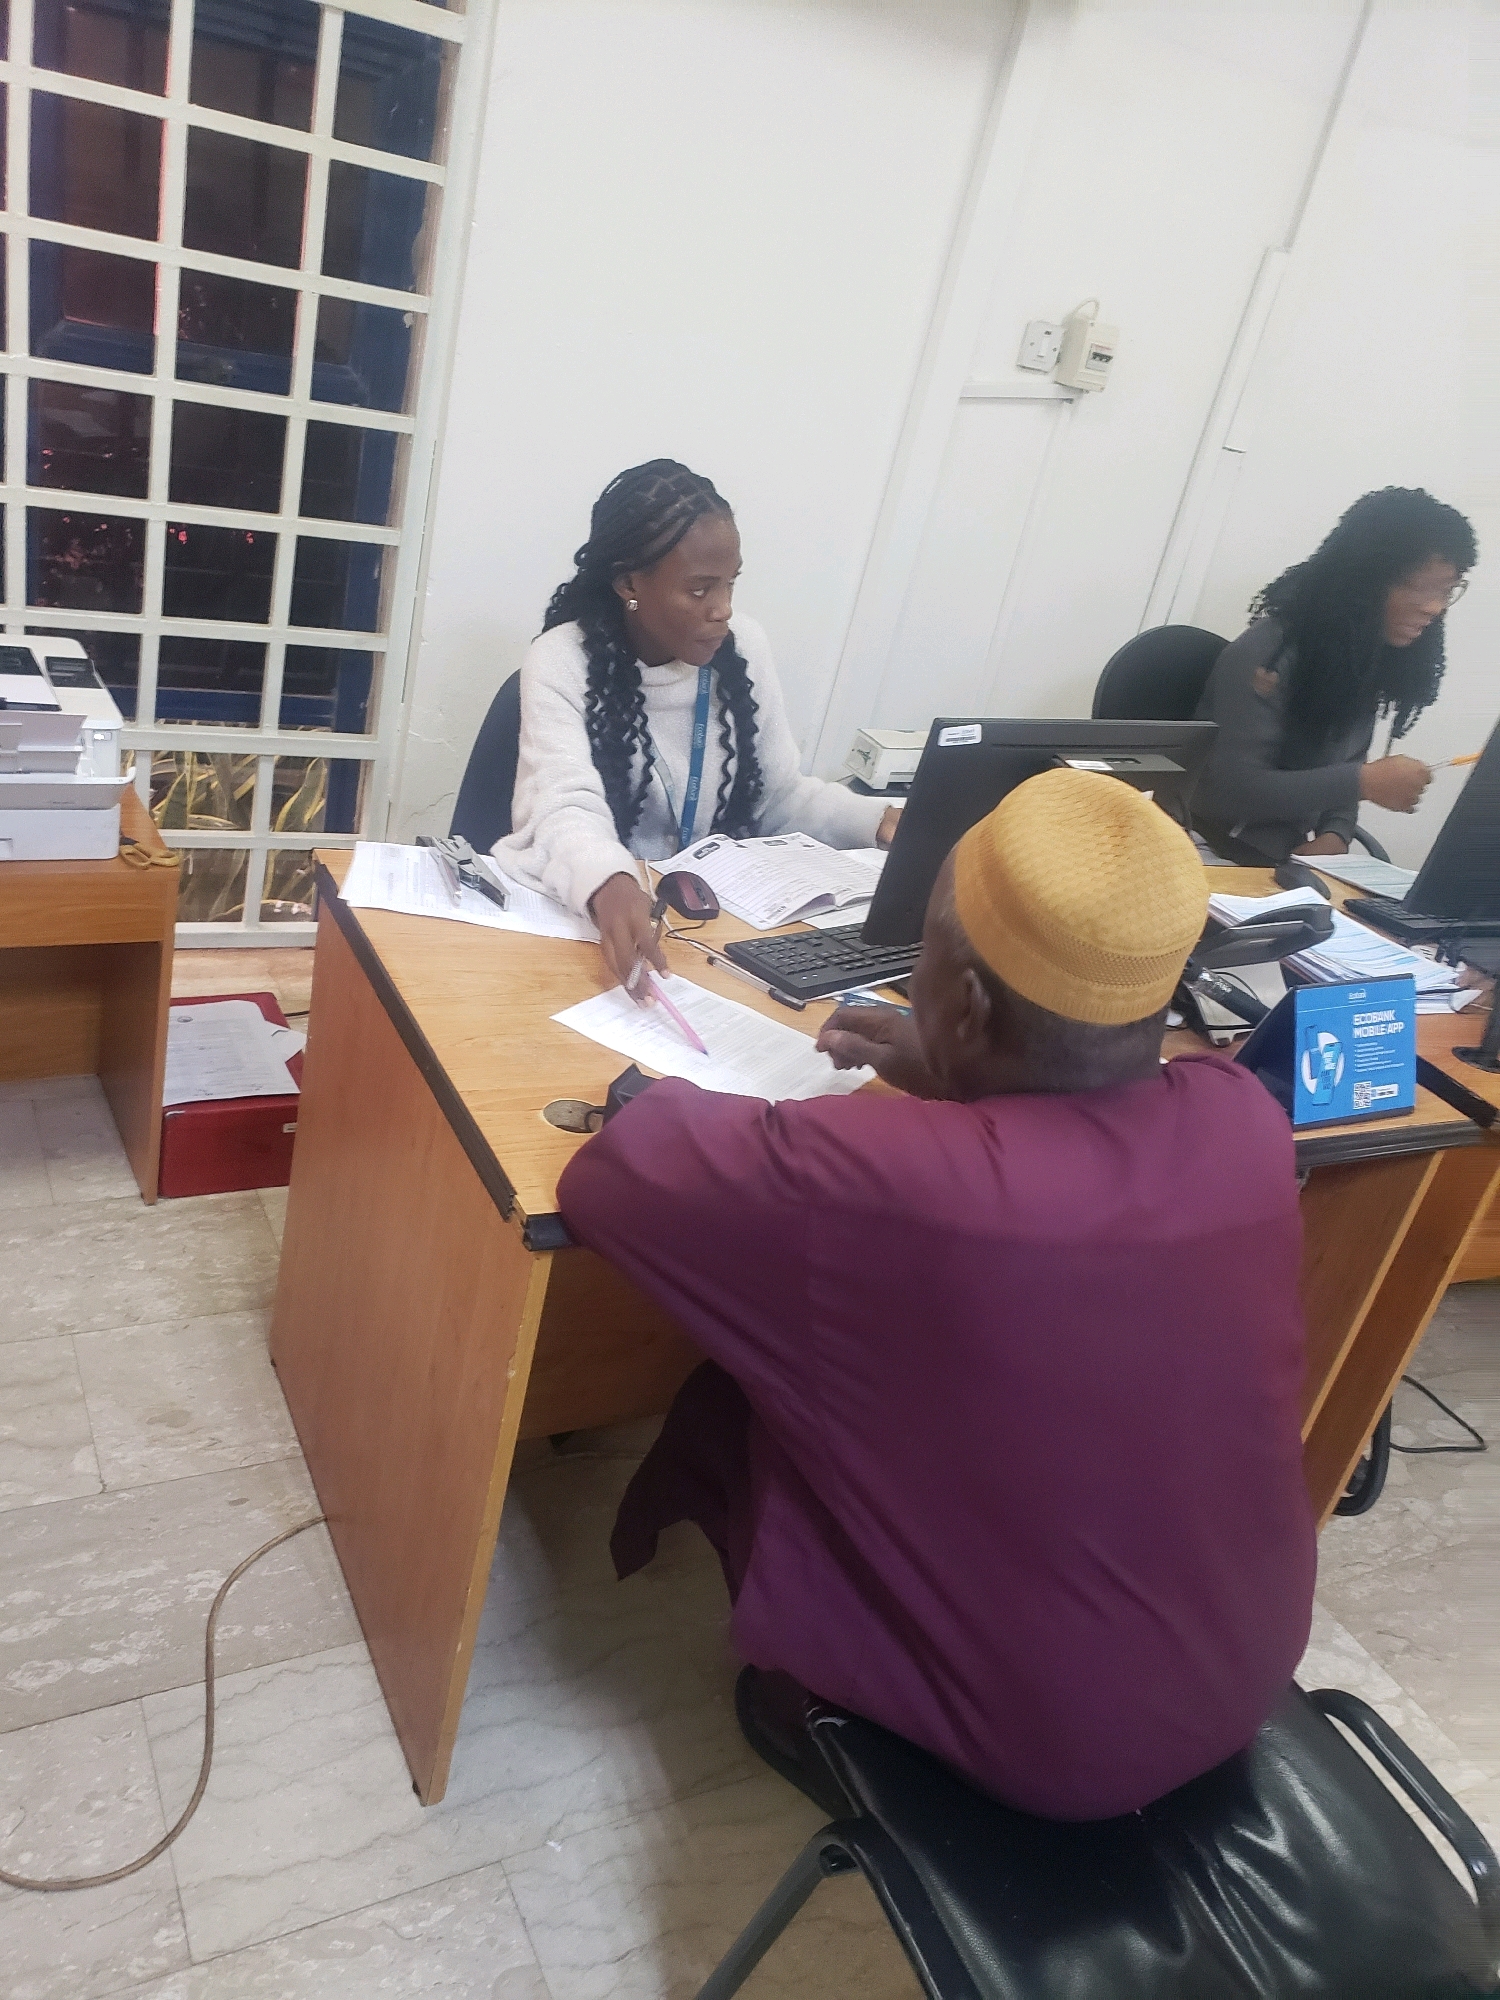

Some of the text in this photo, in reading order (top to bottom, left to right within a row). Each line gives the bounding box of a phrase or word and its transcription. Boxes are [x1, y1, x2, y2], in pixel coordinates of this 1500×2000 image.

[1353, 1009, 1396, 1026] ECOBANK
[1353, 1021, 1404, 1039] MOBILE APP
